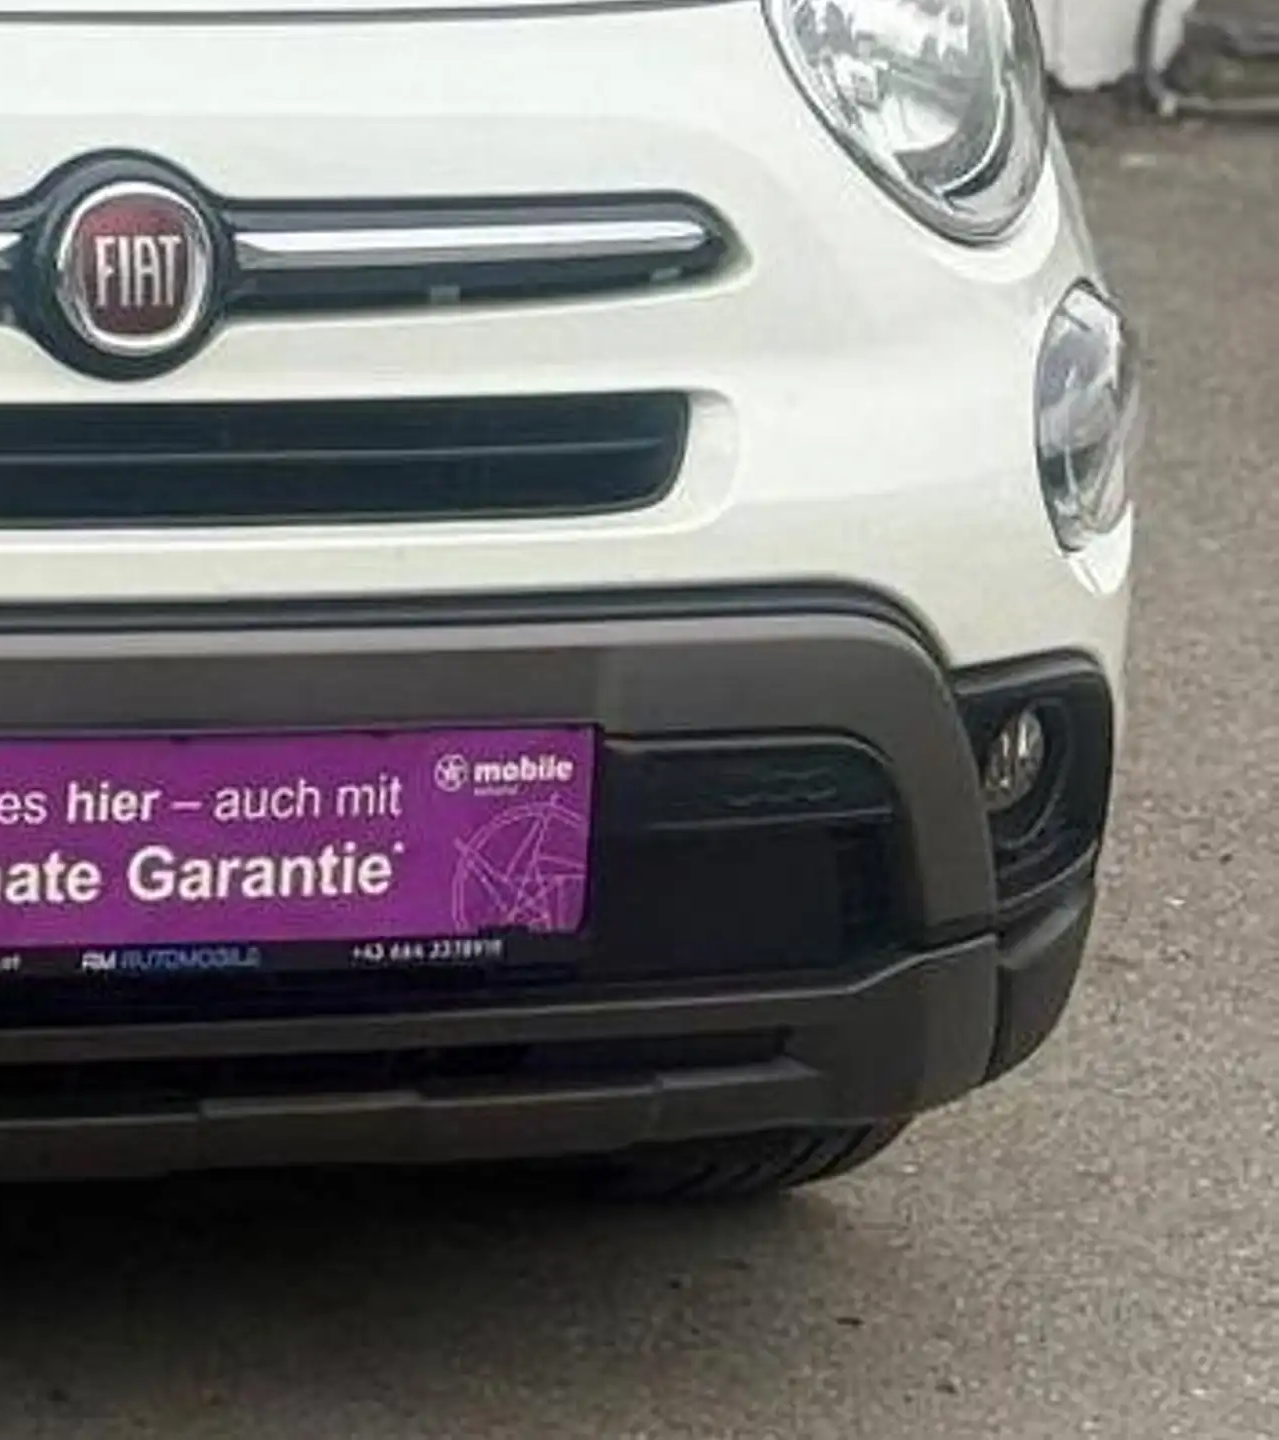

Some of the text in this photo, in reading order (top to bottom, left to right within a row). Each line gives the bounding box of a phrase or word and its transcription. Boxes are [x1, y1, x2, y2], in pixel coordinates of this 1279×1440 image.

[94, 234, 182, 308] FIAT
[473, 753, 573, 782] mobile
[66, 779, 162, 823] hier
[213, 778, 320, 821] auch
[336, 772, 403, 816] mit
